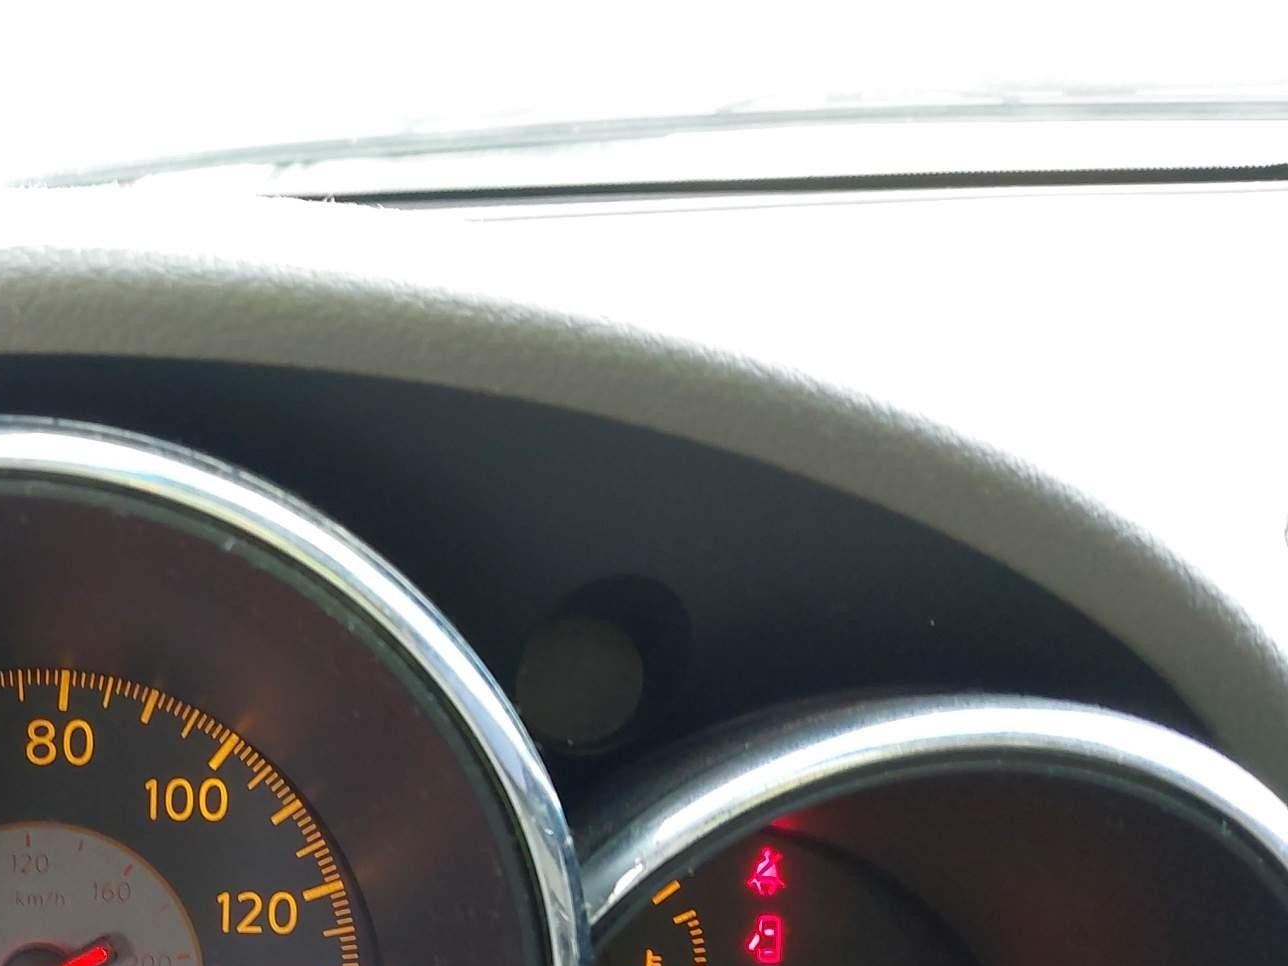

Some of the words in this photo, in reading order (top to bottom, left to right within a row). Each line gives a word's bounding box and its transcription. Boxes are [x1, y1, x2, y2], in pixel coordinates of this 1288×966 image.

[25, 719, 94, 766] 80
[144, 778, 229, 822] 100
[11, 853, 50, 874] 120
[91, 880, 132, 903] 160
[216, 891, 298, 935] 120
